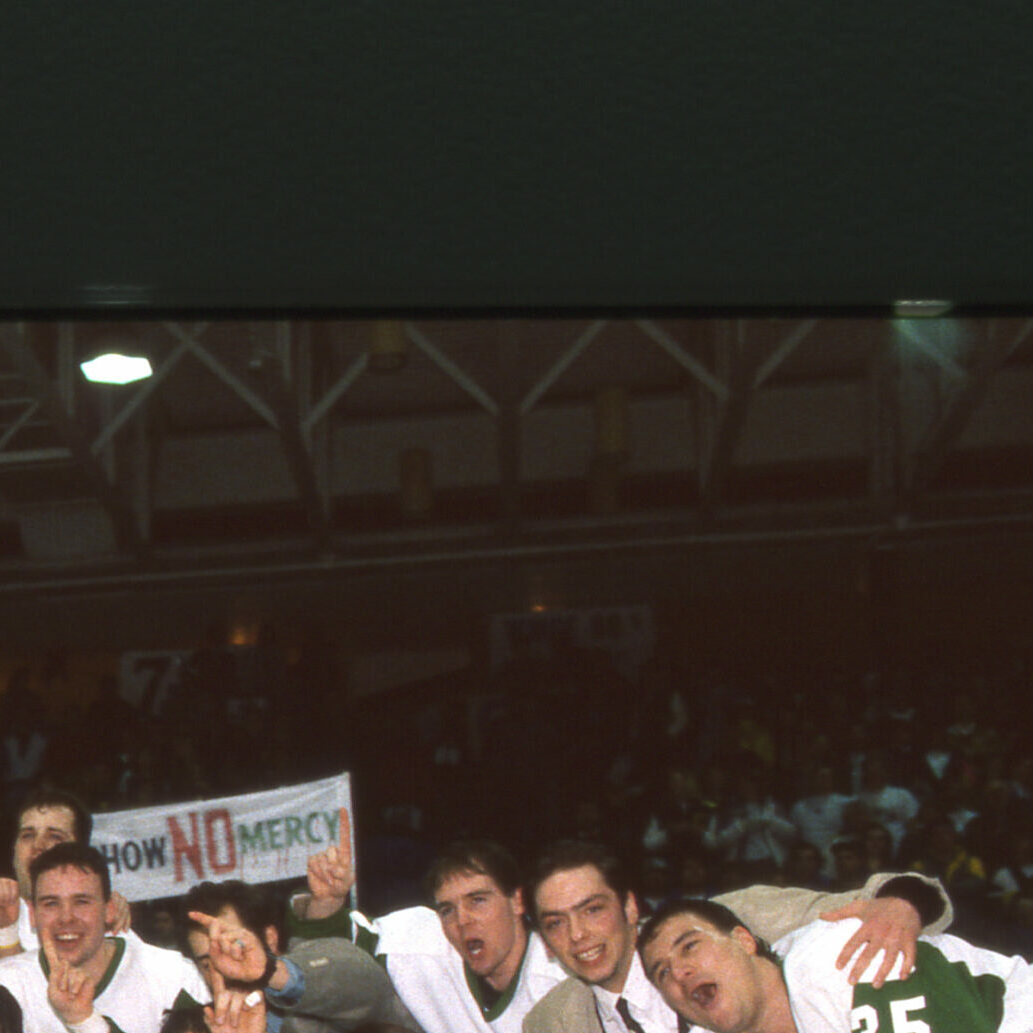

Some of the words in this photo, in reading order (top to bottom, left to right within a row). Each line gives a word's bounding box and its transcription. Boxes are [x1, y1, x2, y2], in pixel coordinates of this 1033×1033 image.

[100, 836, 166, 874] HOW
[166, 808, 237, 882] NO
[237, 808, 340, 853] MERCY
